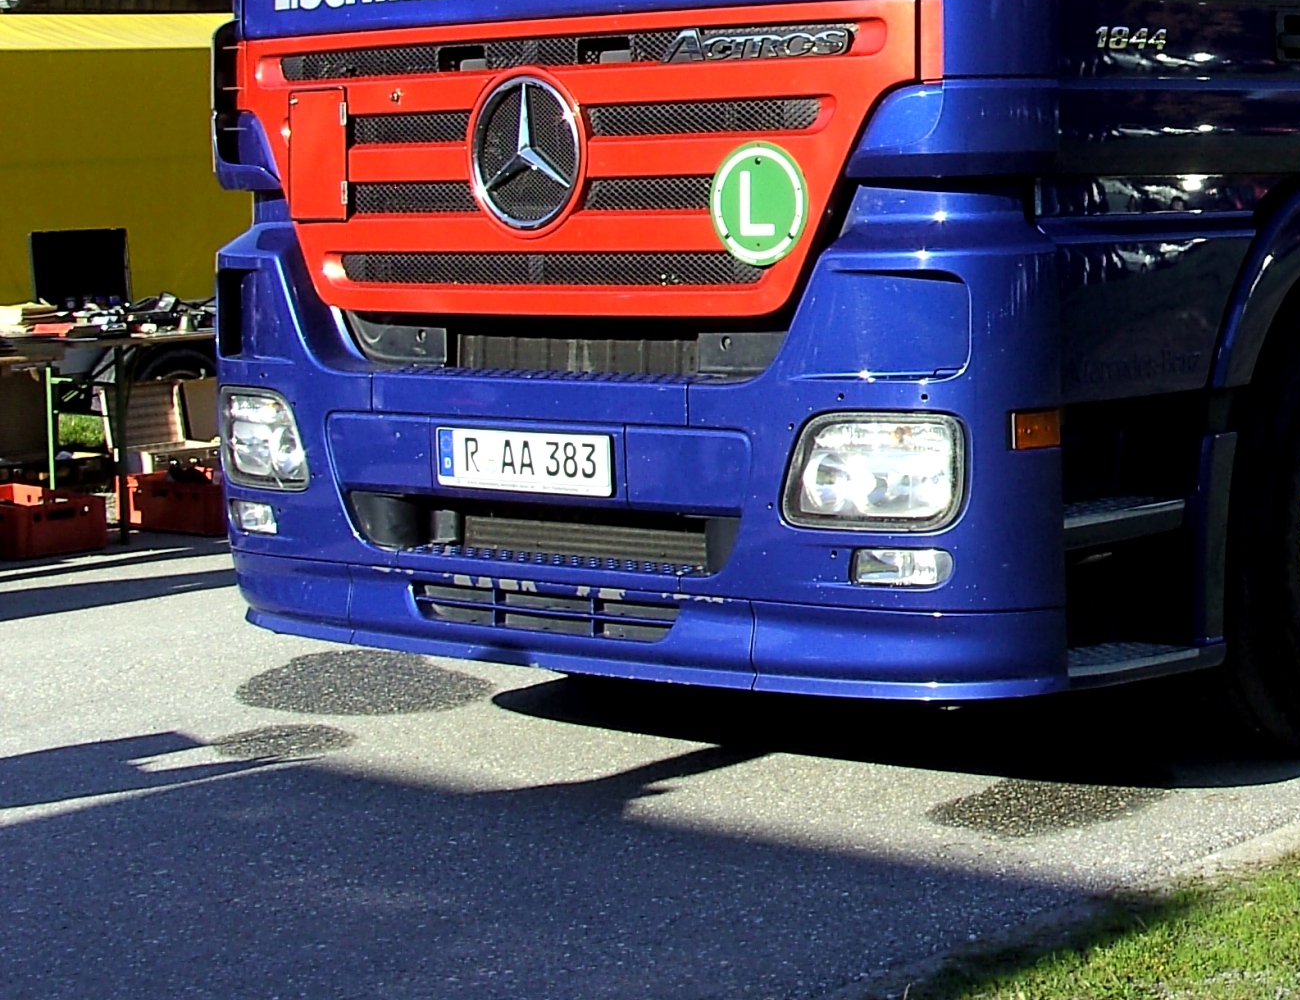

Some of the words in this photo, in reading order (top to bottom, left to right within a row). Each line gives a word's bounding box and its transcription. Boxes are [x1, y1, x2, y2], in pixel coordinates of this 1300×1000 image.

[1095, 25, 1167, 50] 1844
[739, 170, 776, 237] L
[464, 437, 480, 473] R
[501, 439, 535, 476] AA
[545, 441, 597, 479] 383
